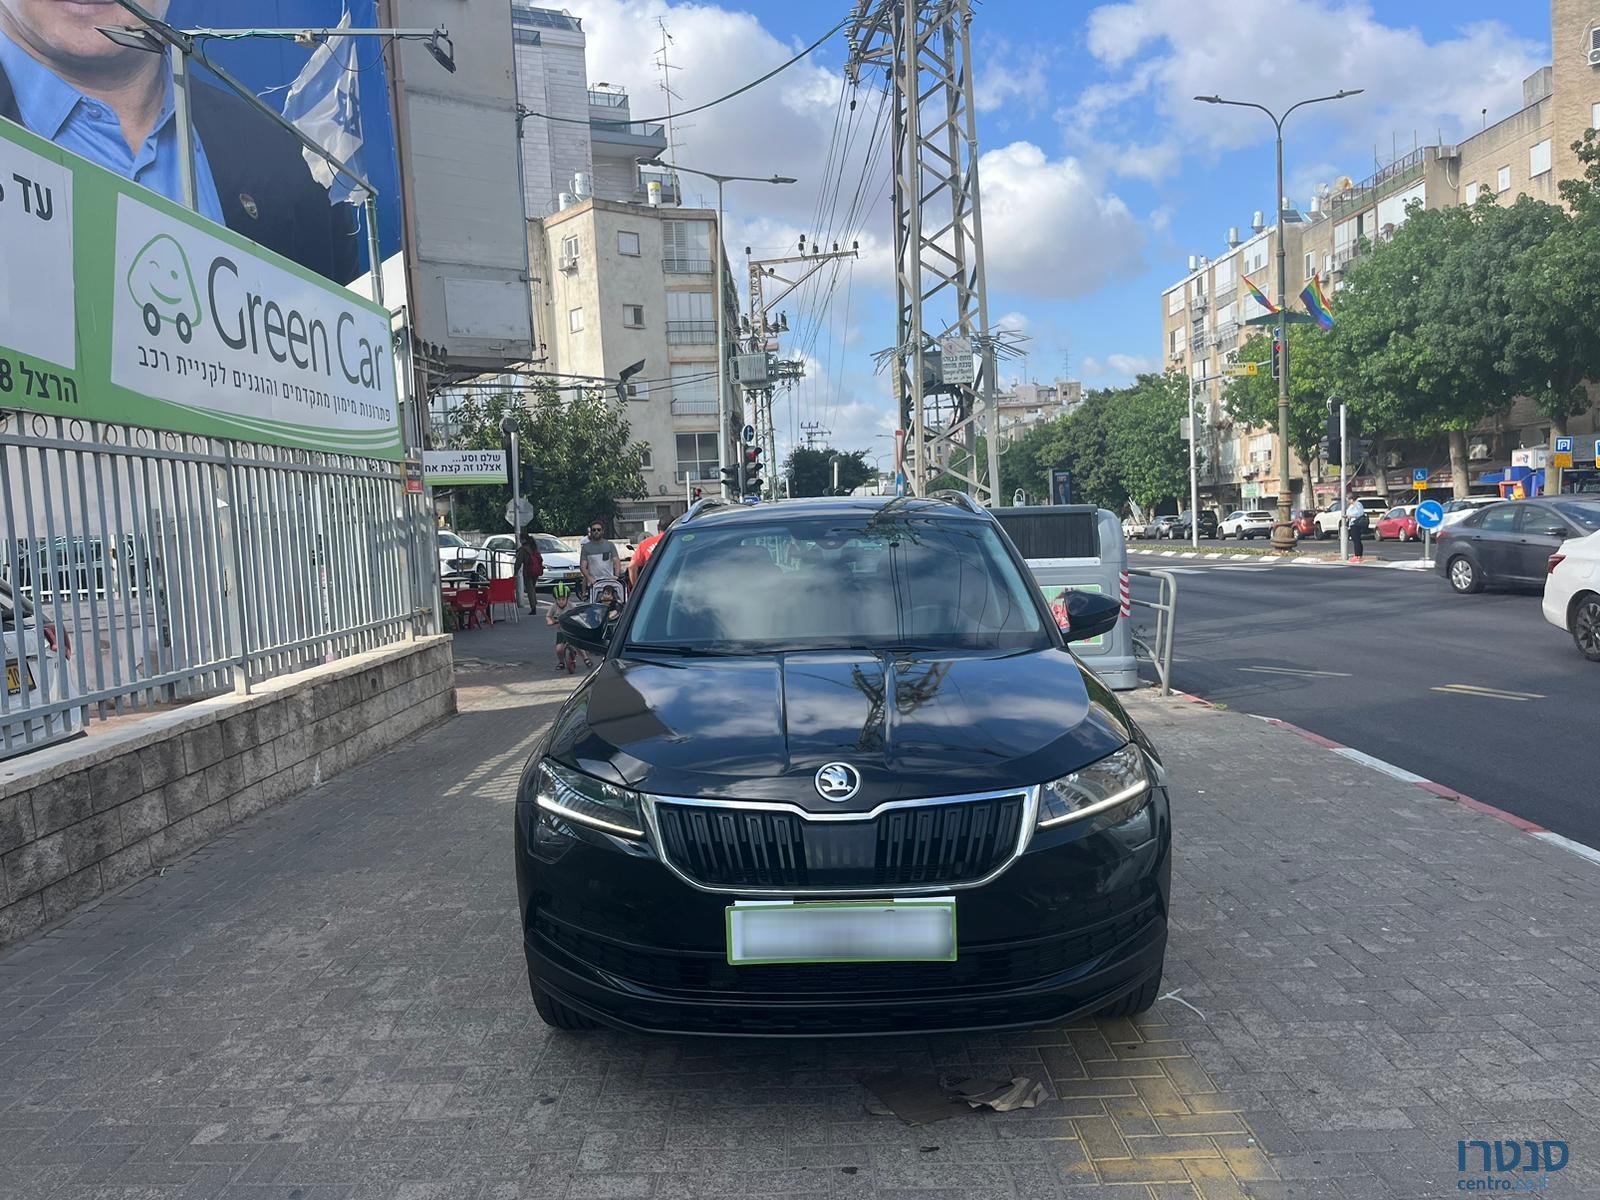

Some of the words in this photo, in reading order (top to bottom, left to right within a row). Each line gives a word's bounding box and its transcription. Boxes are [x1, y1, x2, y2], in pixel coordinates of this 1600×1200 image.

[12, 172, 54, 222] עד
[207, 256, 332, 377] Green
[336, 311, 383, 392] Car
[137, 345, 170, 373] רכב
[176, 355, 226, 388] לקניית
[18, 360, 79, 404] הרצל
[232, 370, 278, 397] והוגנים
[282, 382, 331, 410] מתקדמים
[333, 395, 358, 415] מימון
[359, 401, 391, 422] פתרונות
[441, 463, 461, 474] קצת
[463, 463, 474, 472] זה
[476, 462, 502, 472] אצלנו
[480, 453, 501, 462] שלם
